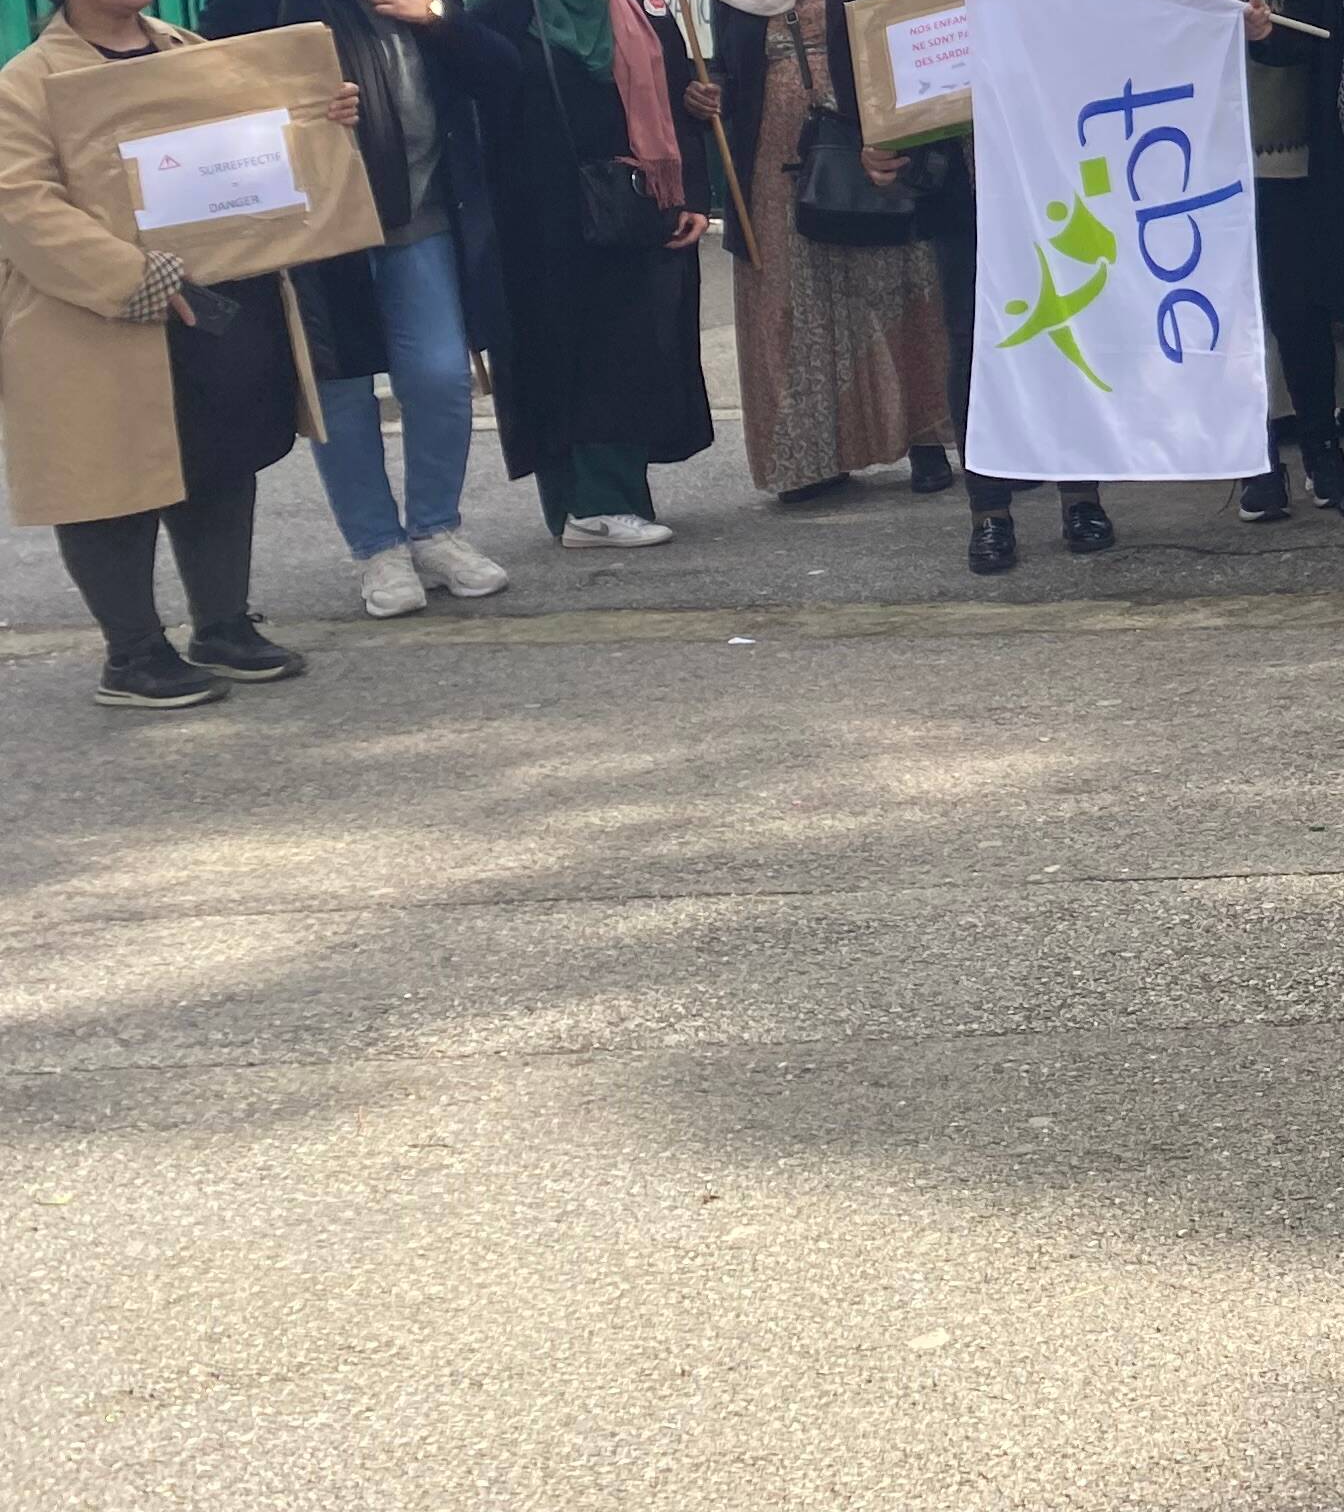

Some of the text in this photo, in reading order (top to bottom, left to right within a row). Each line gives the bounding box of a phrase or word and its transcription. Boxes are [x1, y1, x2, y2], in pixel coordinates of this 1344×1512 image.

[934, 14, 968, 30] ENFAN
[198, 151, 281, 177] SURREFFECTIF
[208, 194, 261, 214] DANGER
